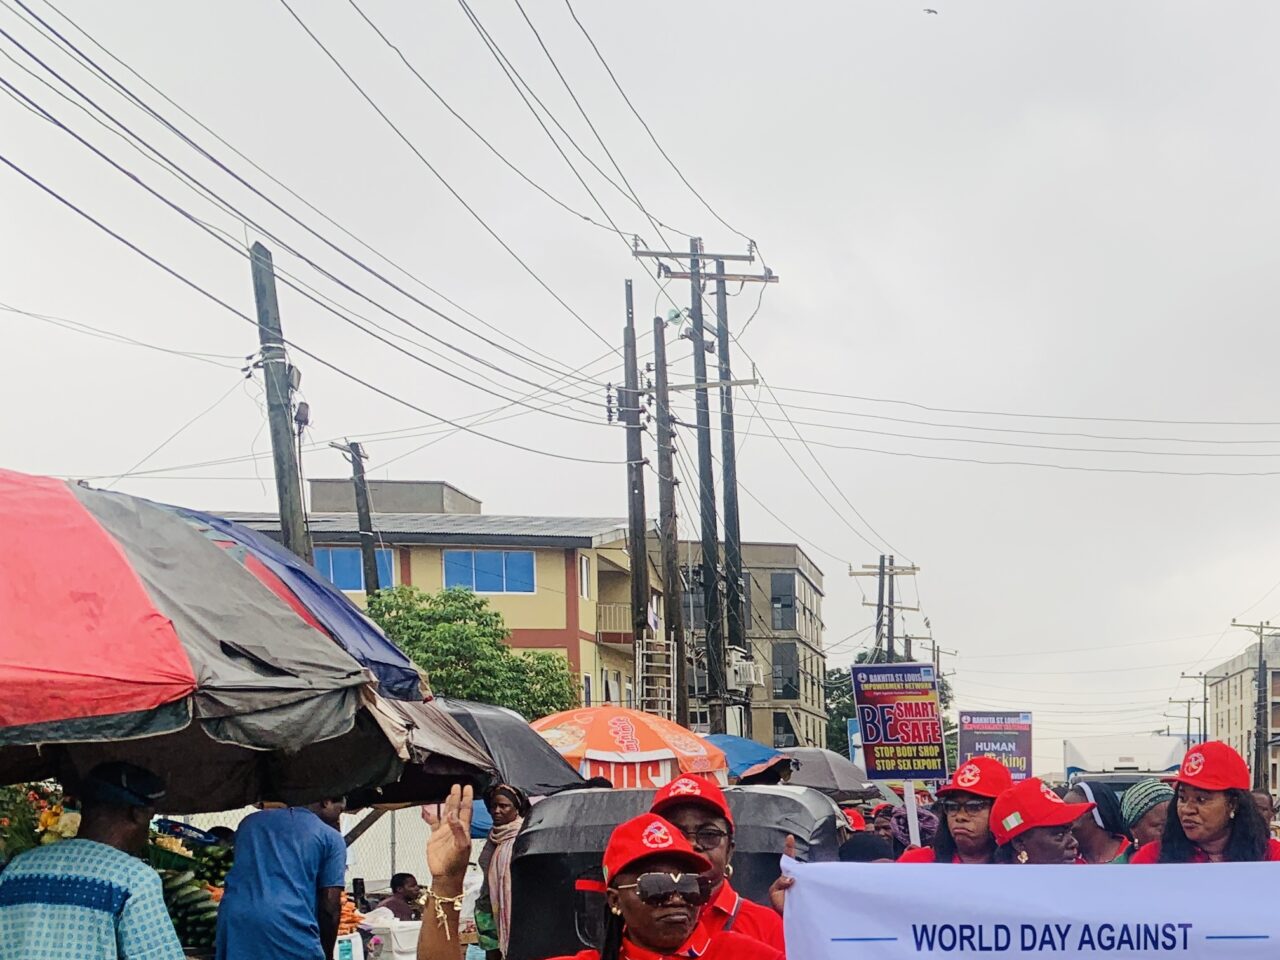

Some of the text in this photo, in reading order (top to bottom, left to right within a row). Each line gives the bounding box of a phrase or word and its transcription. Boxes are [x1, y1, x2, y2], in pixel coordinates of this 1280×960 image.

[896, 702, 938, 720] SMART,
[858, 705, 900, 744] BE
[898, 720, 942, 744] SAFE
[874, 745, 940, 758] STOP BODY SHOP
[975, 742, 1016, 751] HUMAN
[875, 758, 942, 771] STOP SEX EXPORT
[912, 923, 1193, 952] WORLD DAY AGAINST
